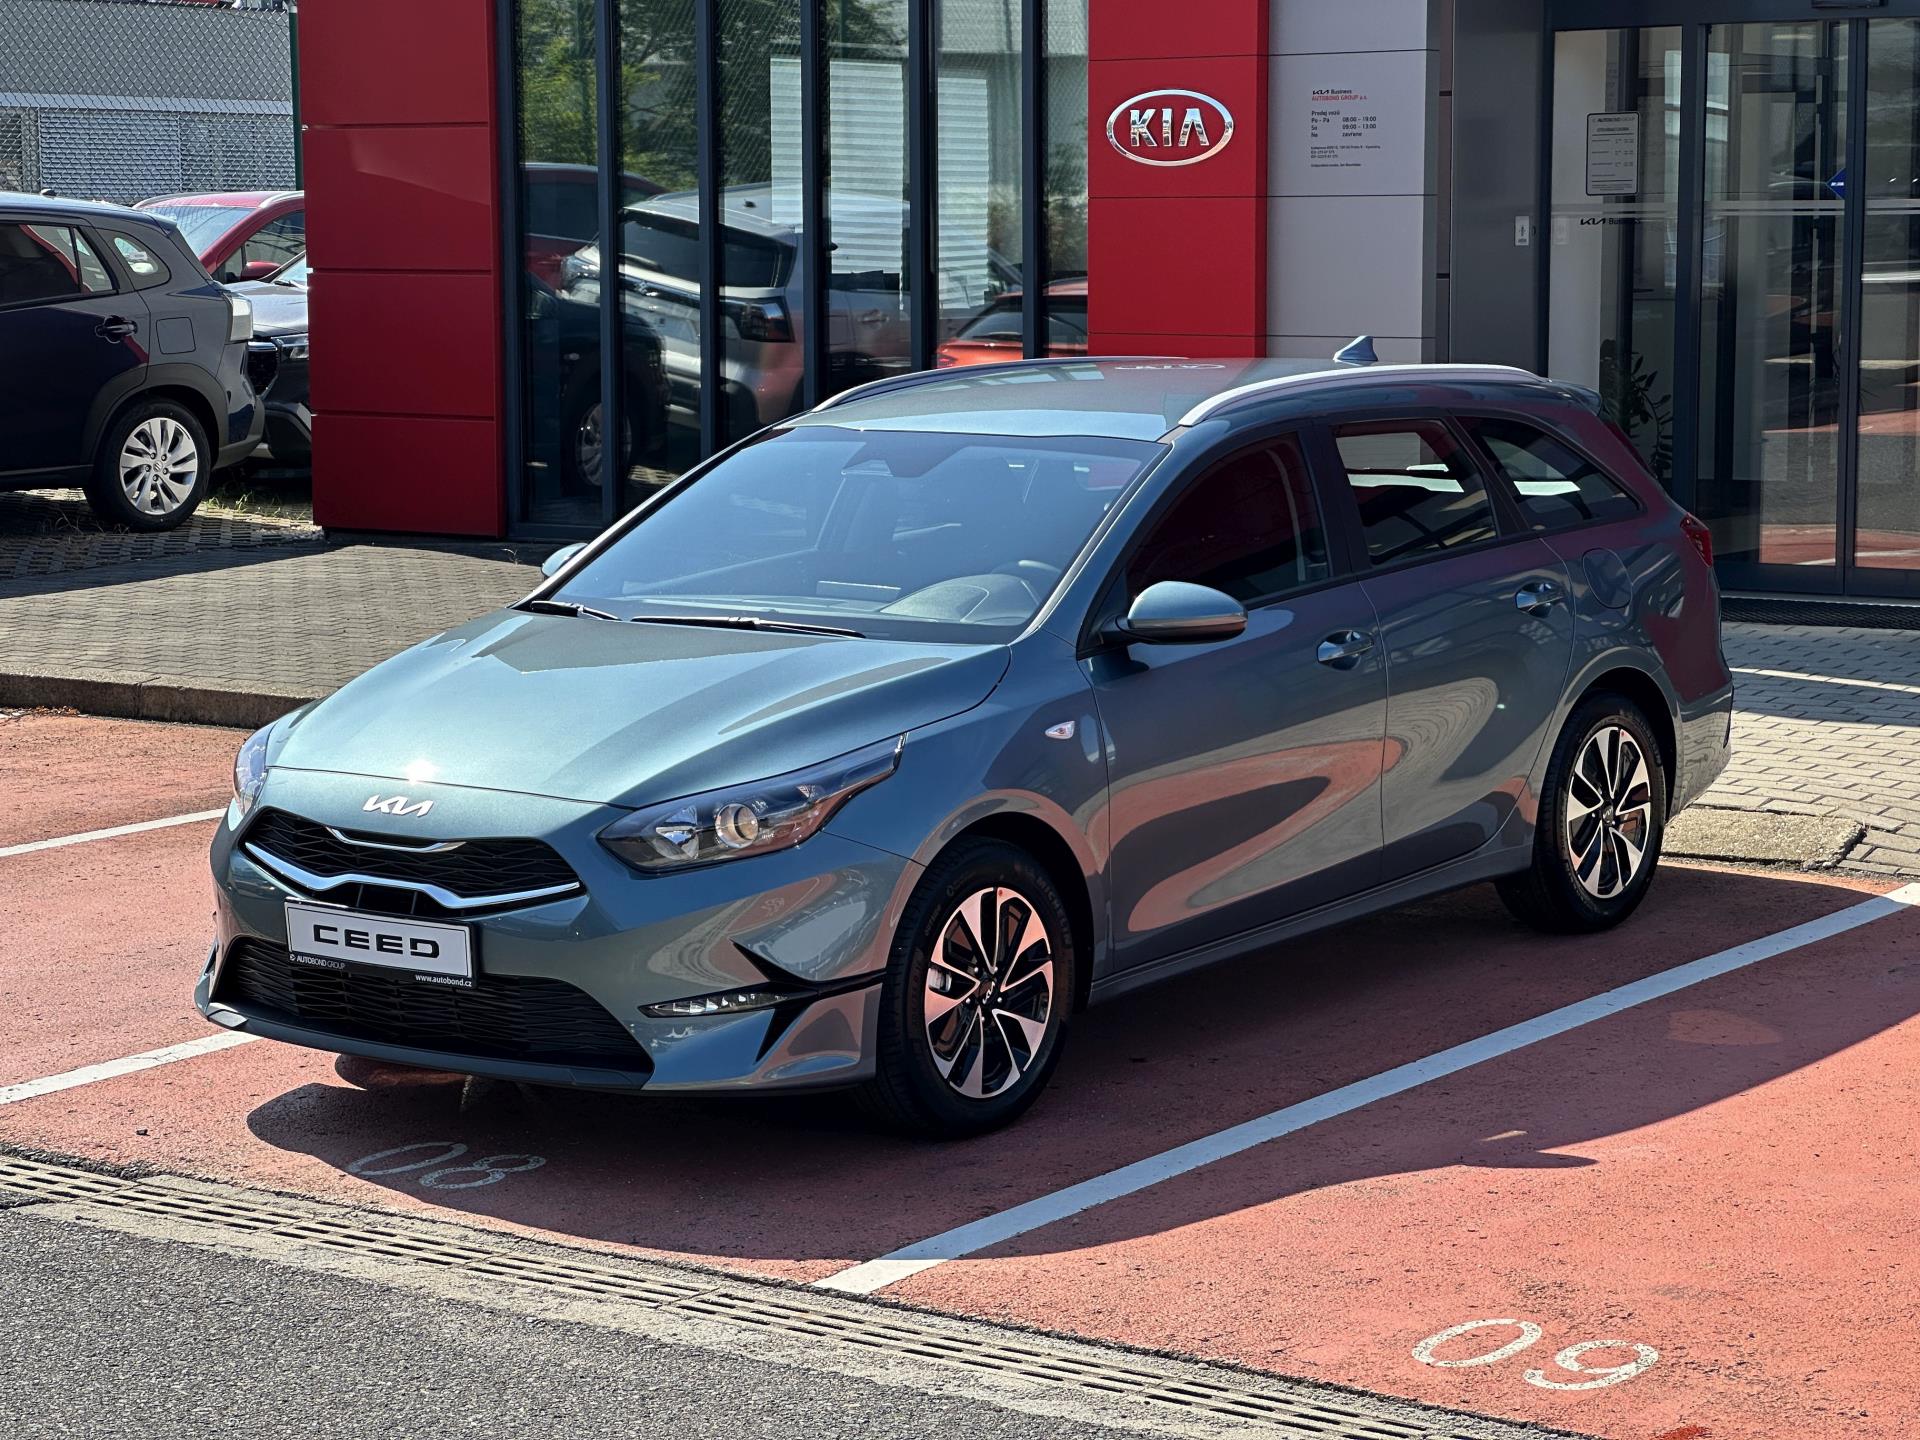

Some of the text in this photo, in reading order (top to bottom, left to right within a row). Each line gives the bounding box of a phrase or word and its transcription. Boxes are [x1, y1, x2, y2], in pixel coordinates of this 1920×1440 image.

[1129, 108, 1210, 147] KIA
[1580, 217, 1606, 226] KIA
[362, 793, 434, 818] KIA
[313, 924, 440, 959] CEED
[296, 954, 346, 970] AUTOBOND GROUP
[415, 974, 472, 988] www.autobond.cz
[346, 1141, 547, 1189] 08
[1411, 1318, 1660, 1391] 09
